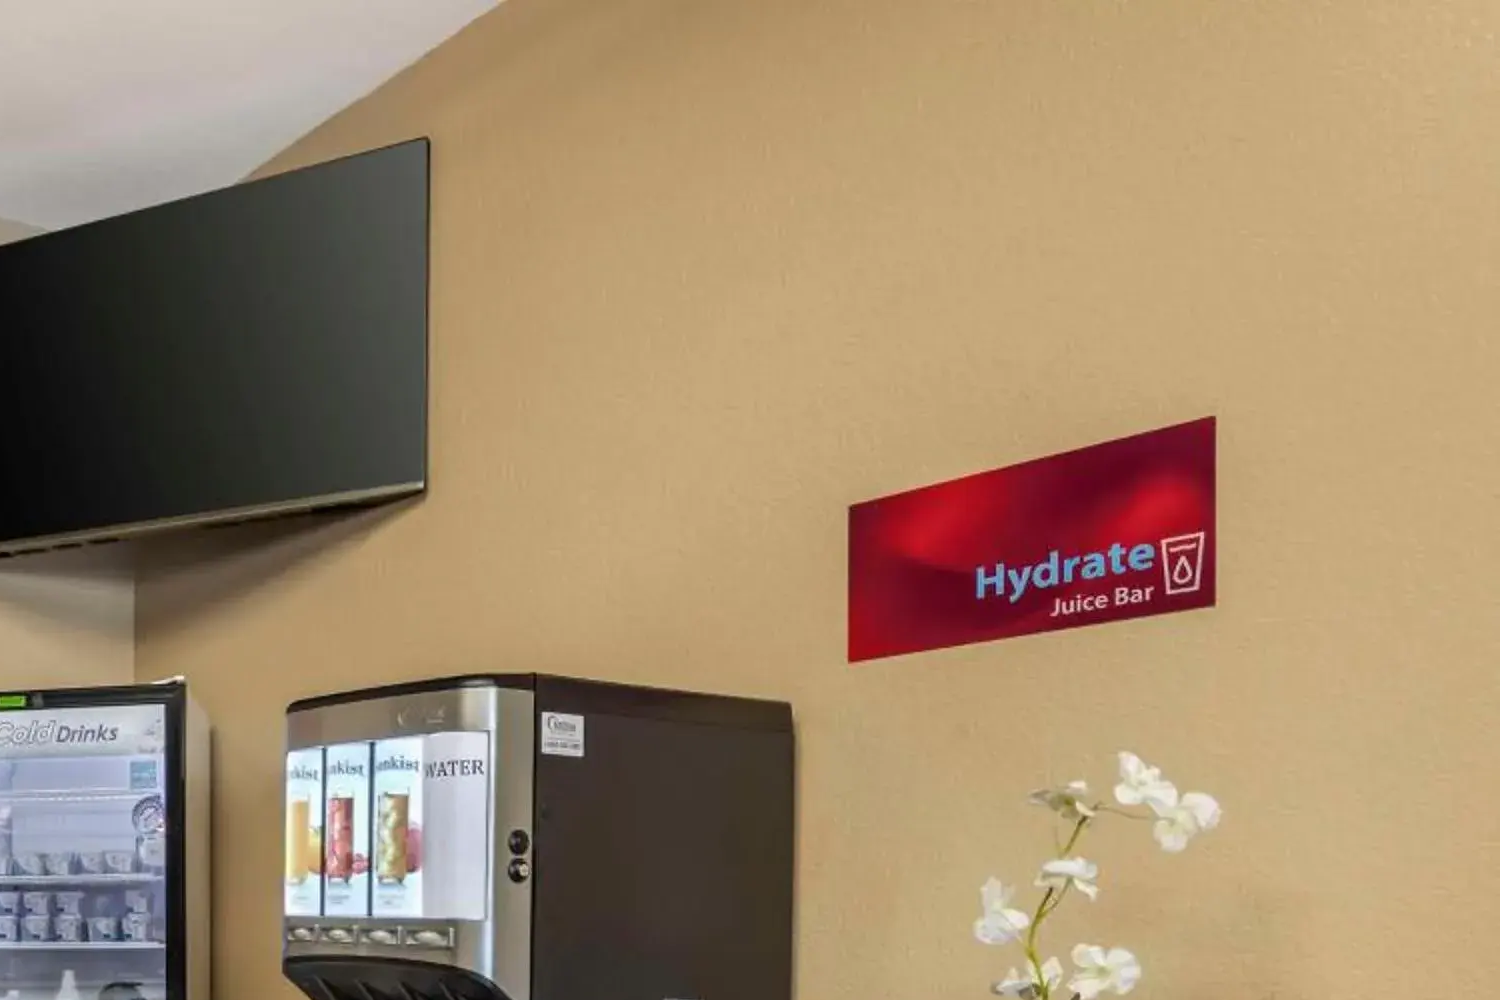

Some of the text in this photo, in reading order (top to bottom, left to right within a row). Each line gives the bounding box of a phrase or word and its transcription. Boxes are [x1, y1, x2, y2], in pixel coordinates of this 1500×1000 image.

[975, 542, 1156, 604] Hydrate
[1050, 586, 1155, 617] Juice Bar
[56, 722, 120, 743] Drinks
[425, 759, 485, 778] WATER
